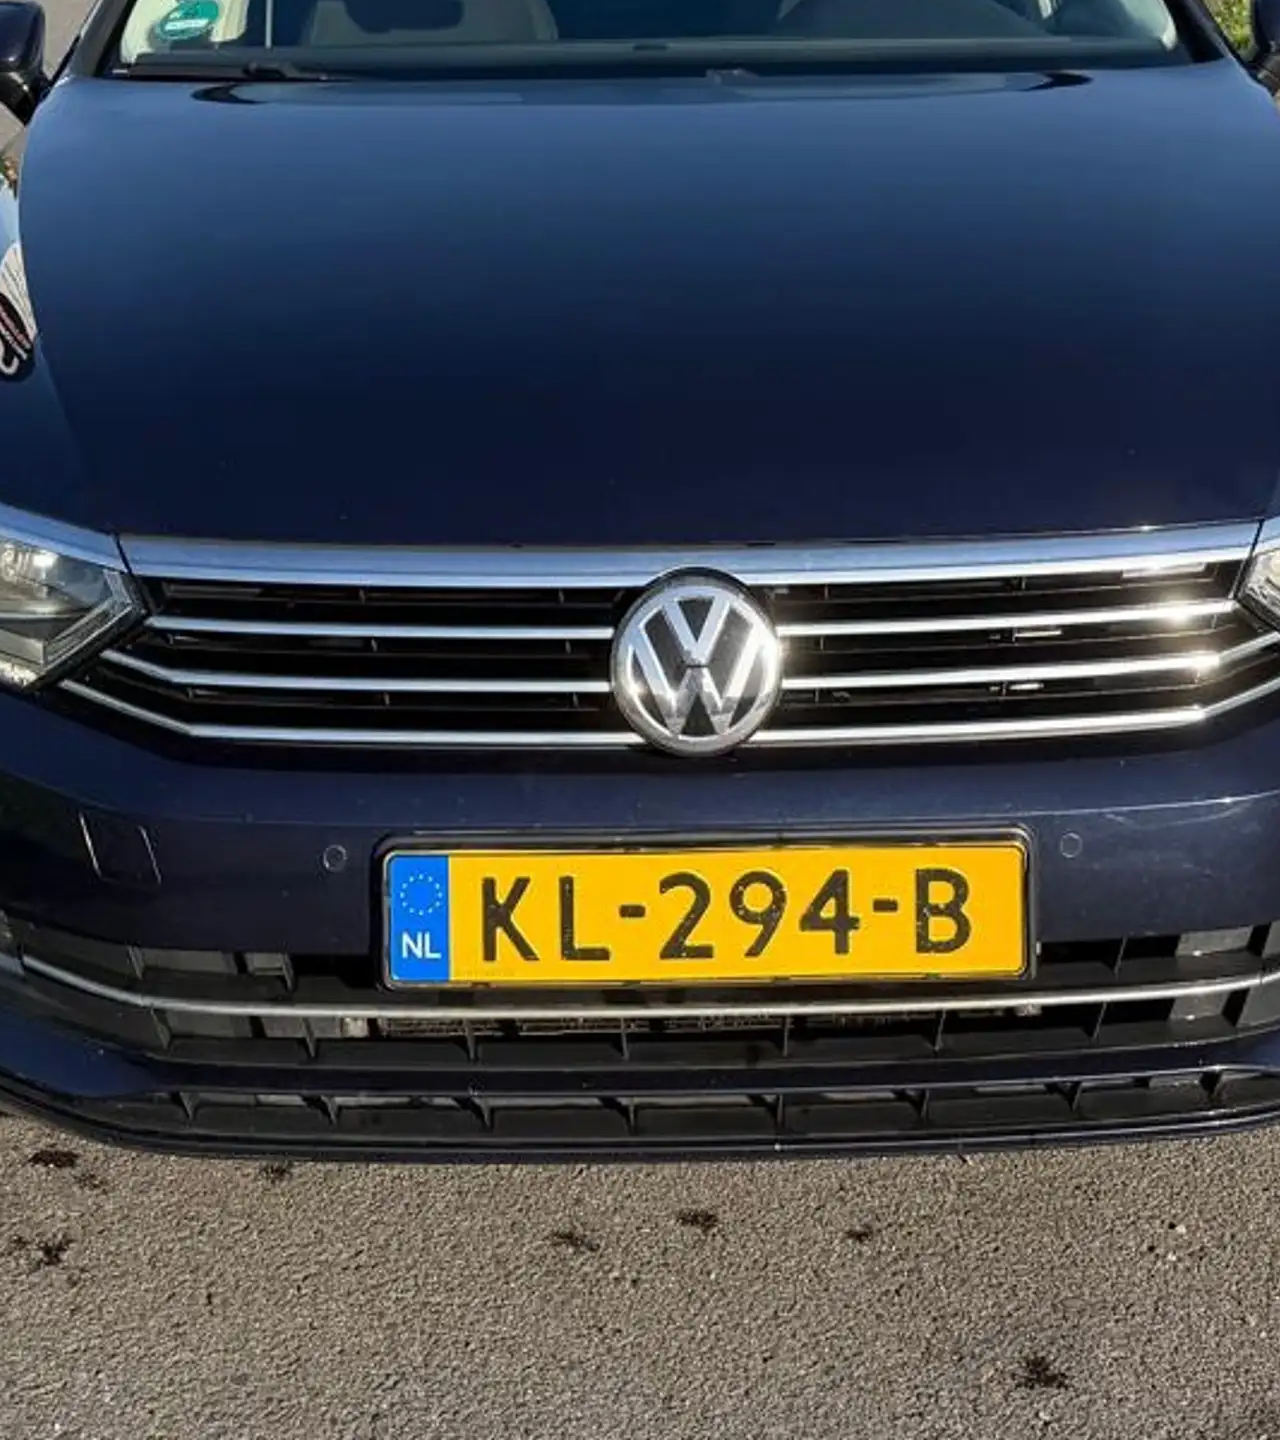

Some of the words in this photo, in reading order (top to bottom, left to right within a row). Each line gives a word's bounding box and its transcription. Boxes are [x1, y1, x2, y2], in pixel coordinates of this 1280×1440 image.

[621, 586, 772, 744] VW
[401, 932, 441, 959] NL
[481, 868, 972, 962] KL-294-B
